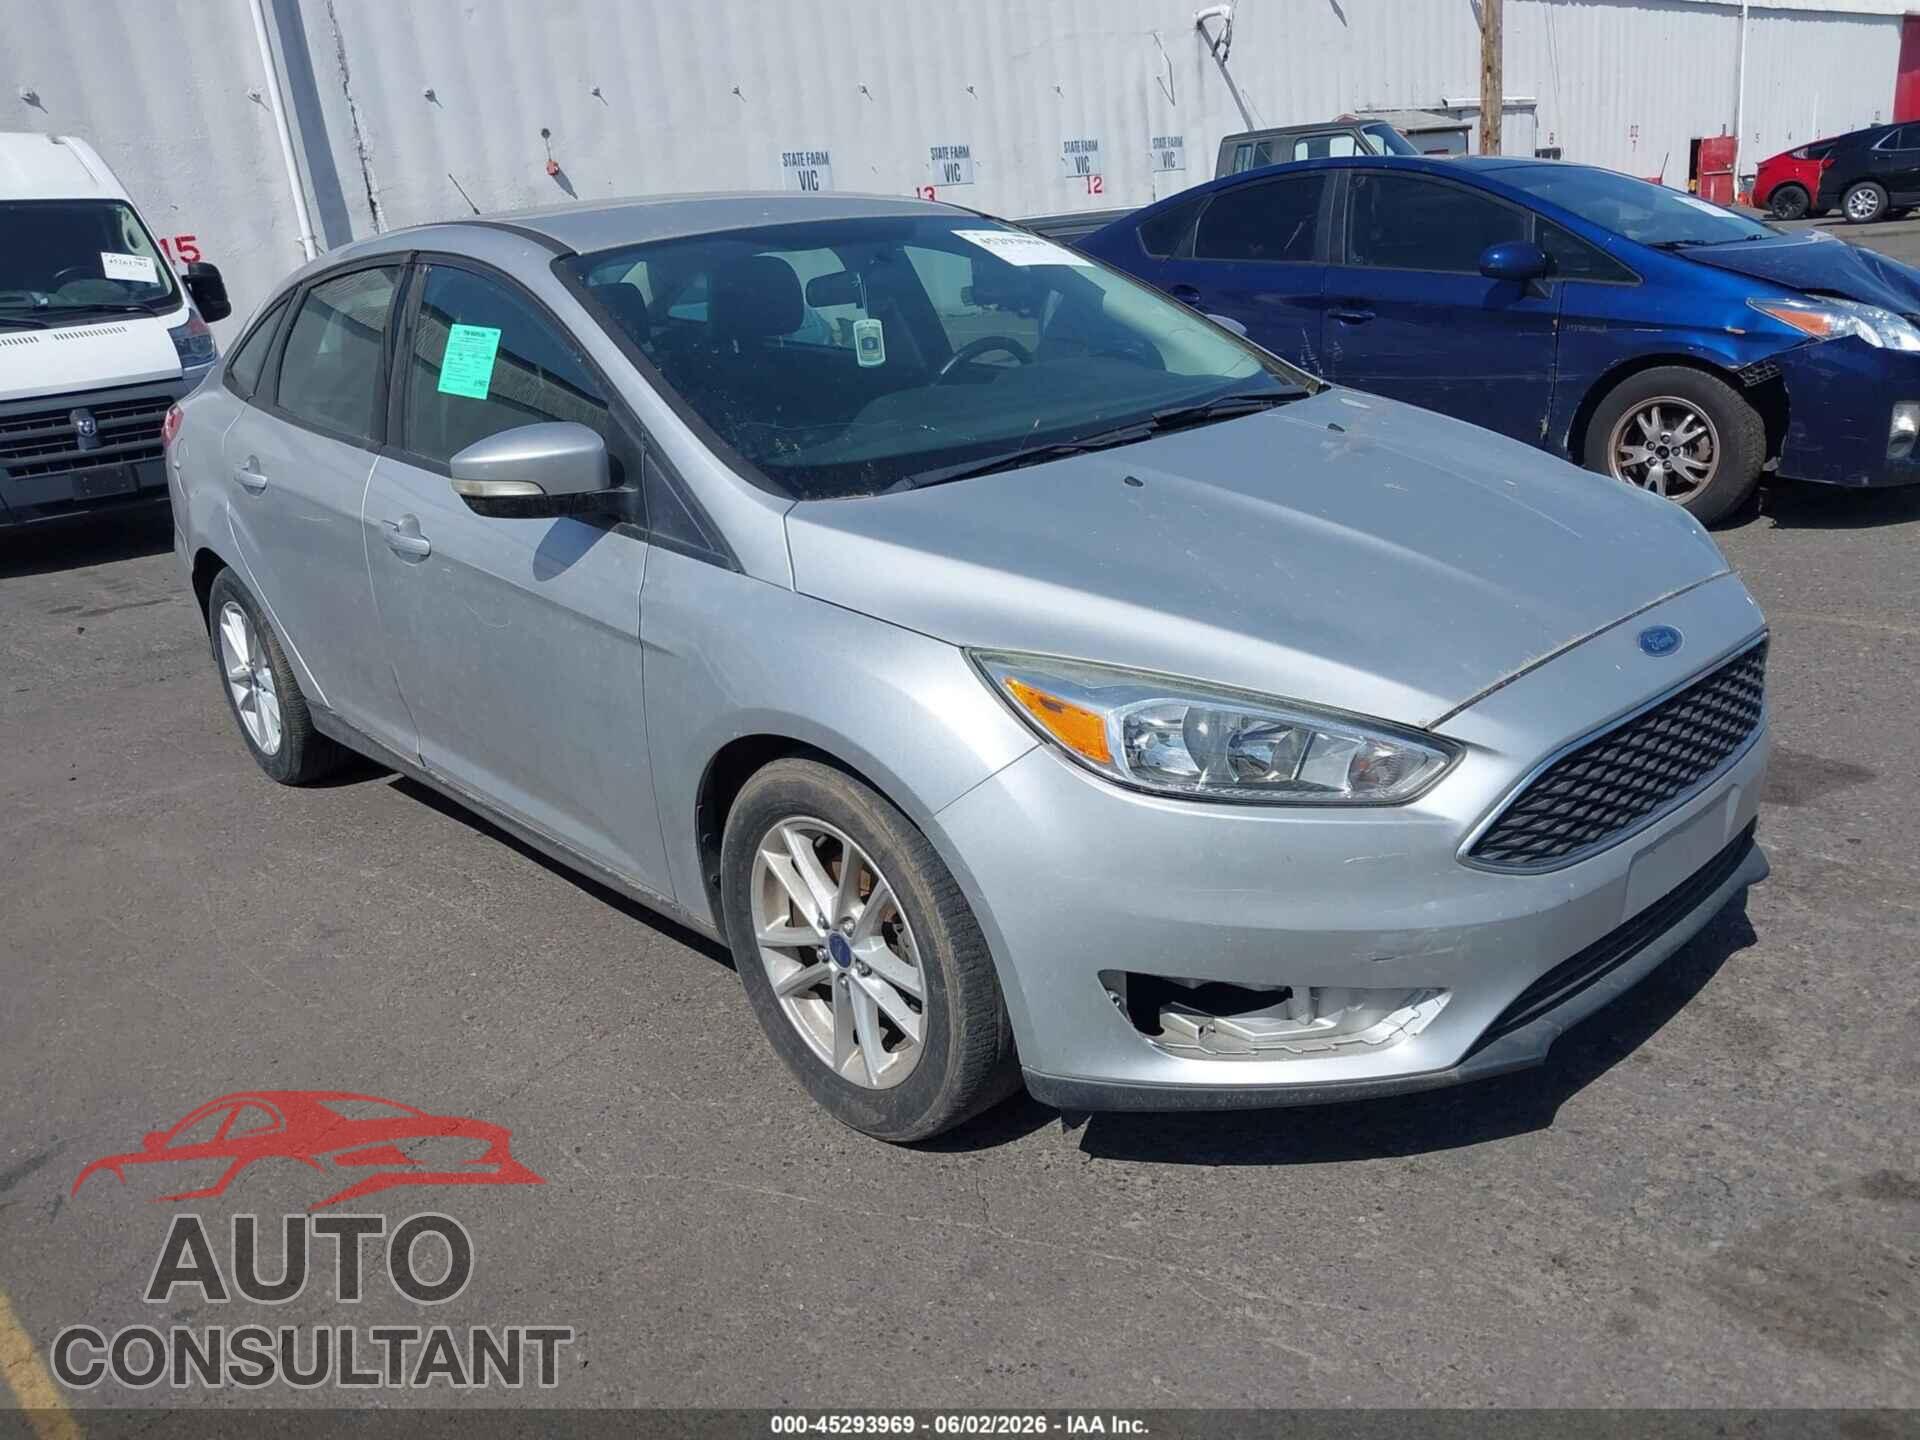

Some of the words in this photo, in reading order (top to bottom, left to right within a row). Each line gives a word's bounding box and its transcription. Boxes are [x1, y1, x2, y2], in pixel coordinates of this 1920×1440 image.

[1064, 140, 1081, 153] STATE
[1081, 139, 1098, 152] FARM
[1152, 137, 1167, 149] STATE
[1168, 136, 1183, 147] FARM
[782, 152, 806, 167] STATE
[806, 151, 830, 166] FARM
[930, 146, 949, 160] STATE
[949, 145, 969, 159] FARM
[1161, 152, 1176, 168] VIC
[944, 162, 961, 183] VIC
[1075, 156, 1090, 174] VIC
[798, 170, 820, 191] VIC
[1086, 176, 1102, 194] 12
[160, 235, 201, 264] 15
